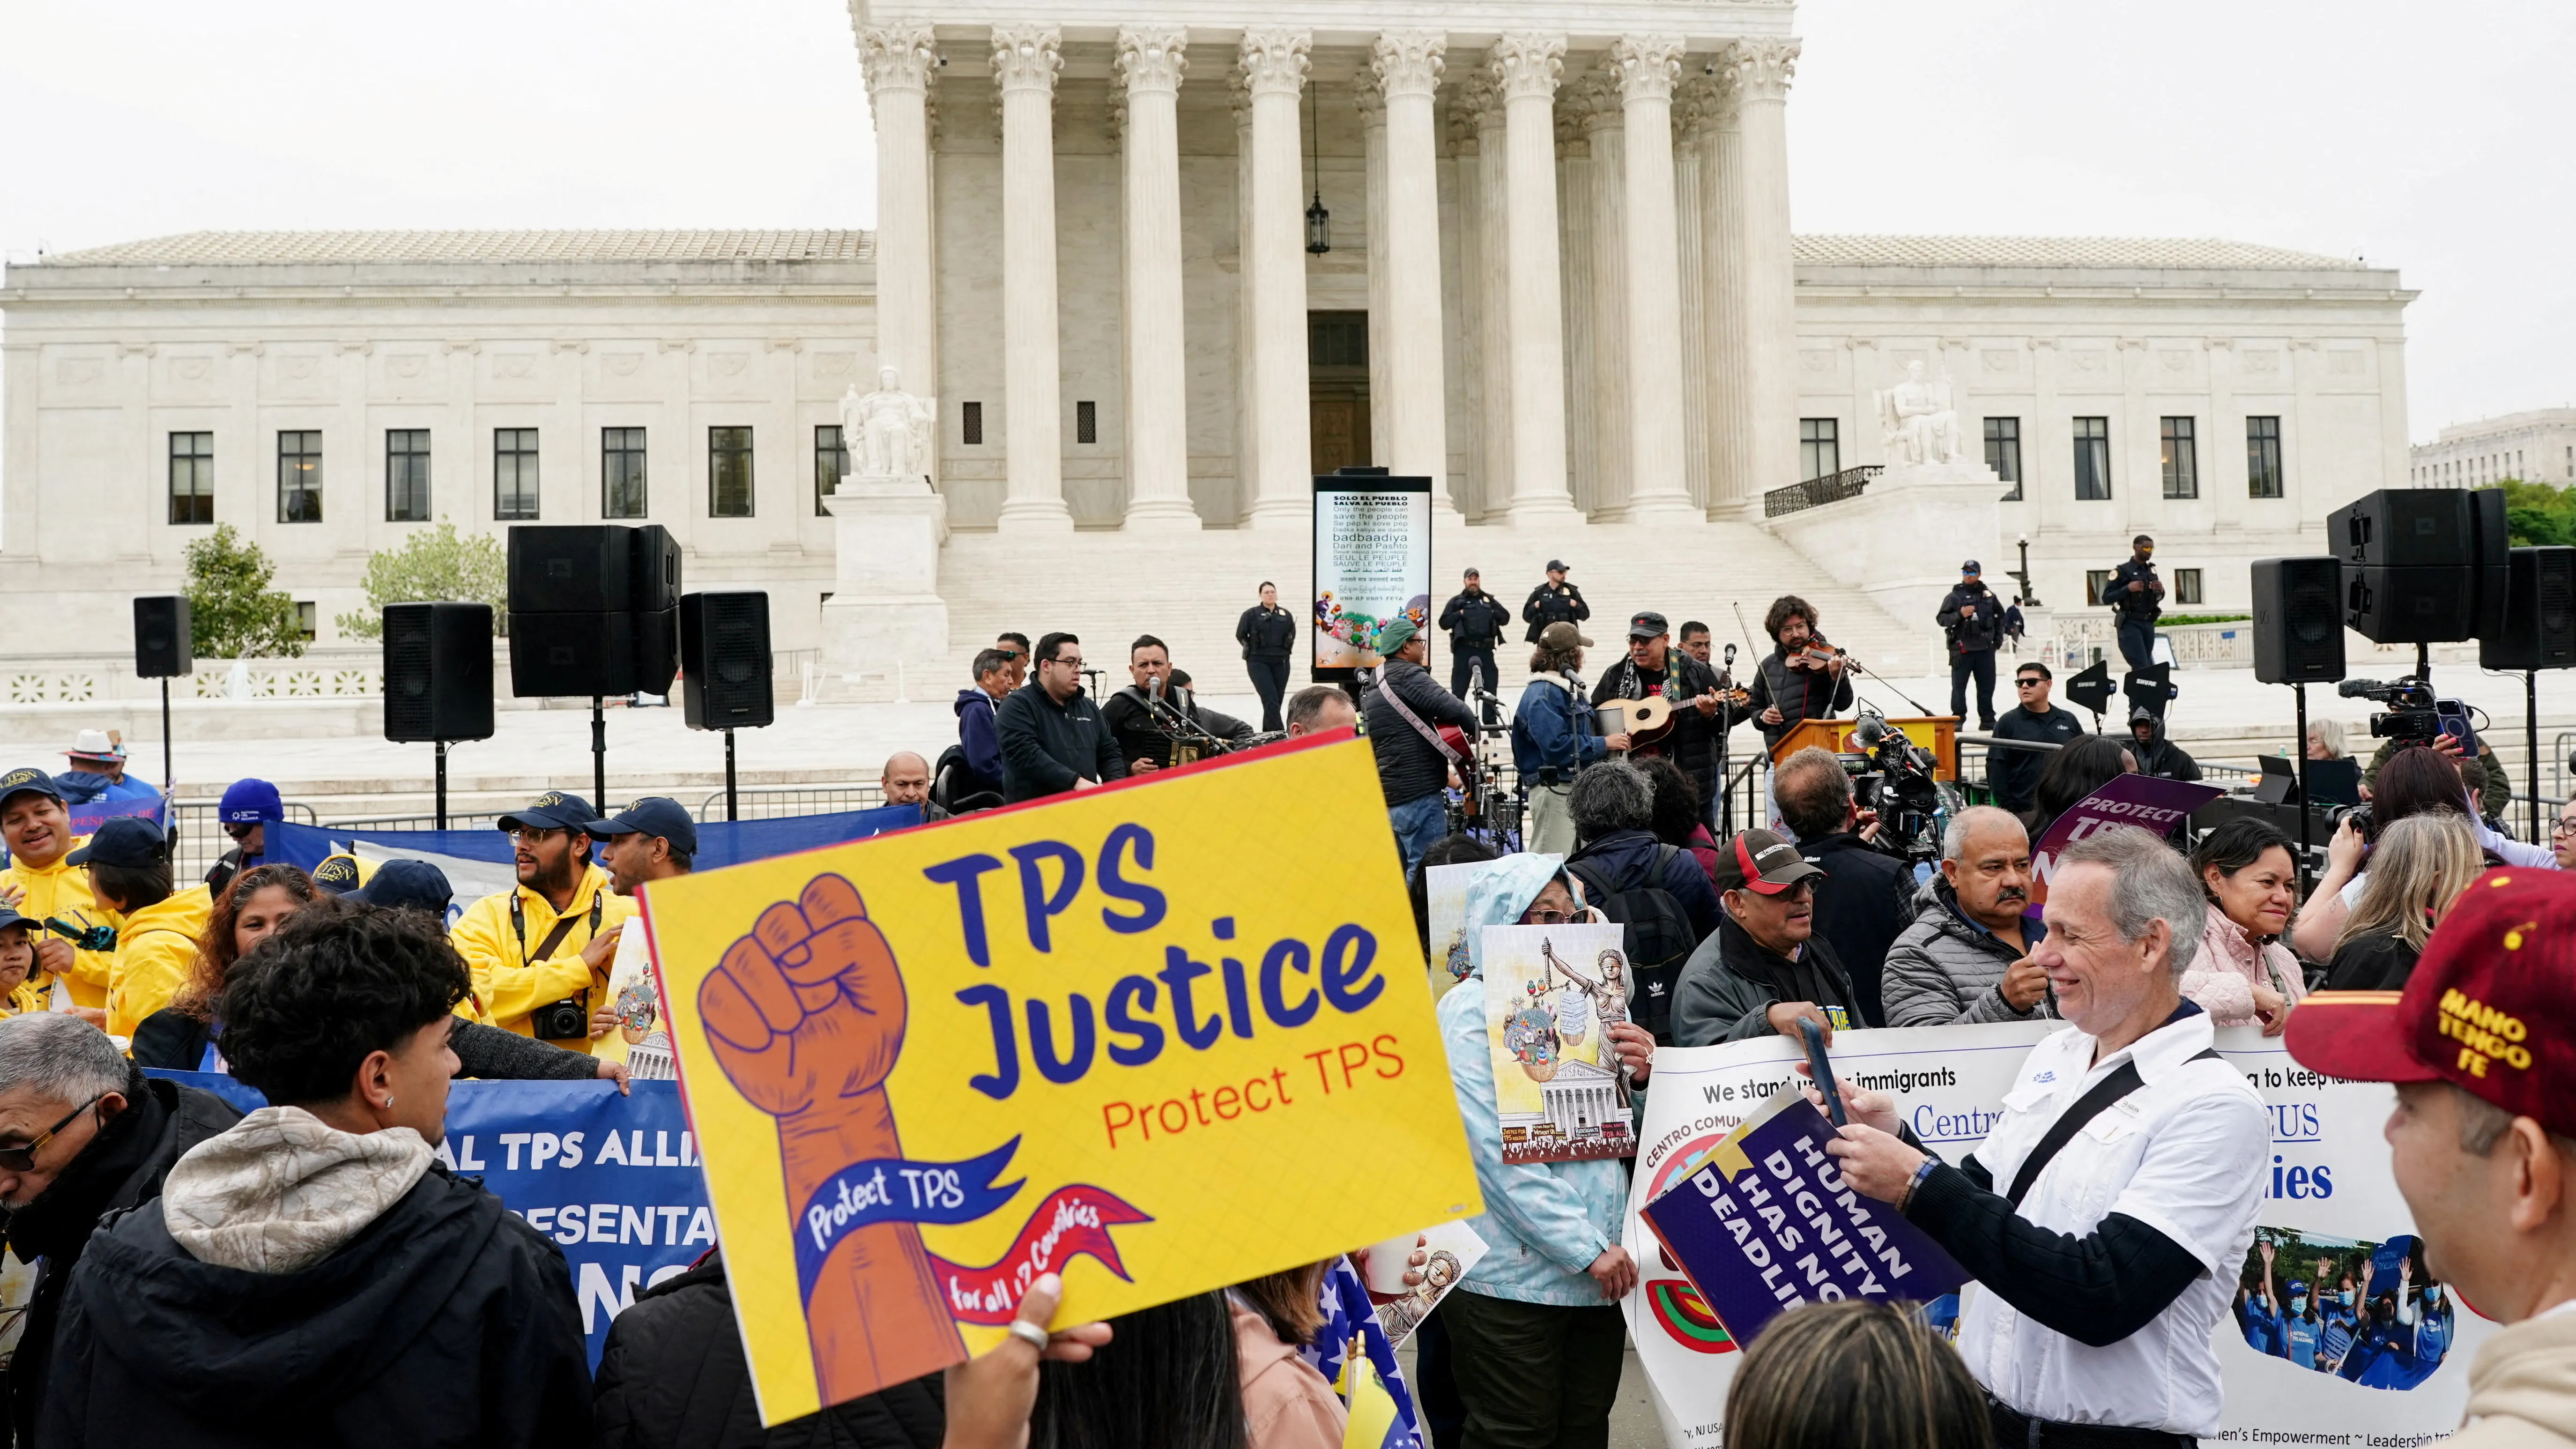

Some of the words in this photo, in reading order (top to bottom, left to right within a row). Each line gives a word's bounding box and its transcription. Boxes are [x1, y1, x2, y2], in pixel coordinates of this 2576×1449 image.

[1333, 533, 1407, 544] badbaadiya
[2136, 678, 2157, 687] SHURE
[138, 808, 156, 819] DE
[2078, 797, 2185, 822] PROTECT
[922, 823, 1167, 967] TPS
[955, 916, 1385, 1100] Justice
[2438, 988, 2527, 1042] MANO
[2438, 1009, 2532, 1070] TENGO
[2264, 1068, 2281, 1088] to
[2286, 1067, 2327, 1090] keep
[2457, 1048, 2490, 1078] FE
[1103, 1067, 1292, 1150] Protect
[1303, 1034, 1404, 1095] TPS
[1703, 1084, 1735, 1105] We
[1856, 1066, 1956, 1094] immigrants
[2266, 1103, 2319, 1137] US
[499, 1130, 585, 1171] TPS
[594, 1129, 702, 1167] ALLI
[1647, 1125, 1691, 1168] CENTRO
[2264, 1155, 2332, 1199] ies
[808, 1167, 892, 1252] Protect
[898, 1169, 965, 1209] TPS
[1764, 1149, 1886, 1296] DIGNITY
[1793, 1135, 1913, 1279] HUMAN
[1738, 1174, 1804, 1252] HAS
[1796, 1253, 1847, 1305] NO
[950, 1275, 981, 1312] for
[985, 1282, 1012, 1313] all
[1014, 1261, 1032, 1297] 17
[1696, 1425, 1705, 1436] NJ
[1707, 1422, 1723, 1434] USA
[2253, 1429, 2350, 1446] Empowerment
[2367, 1433, 2432, 1448] Leadership
